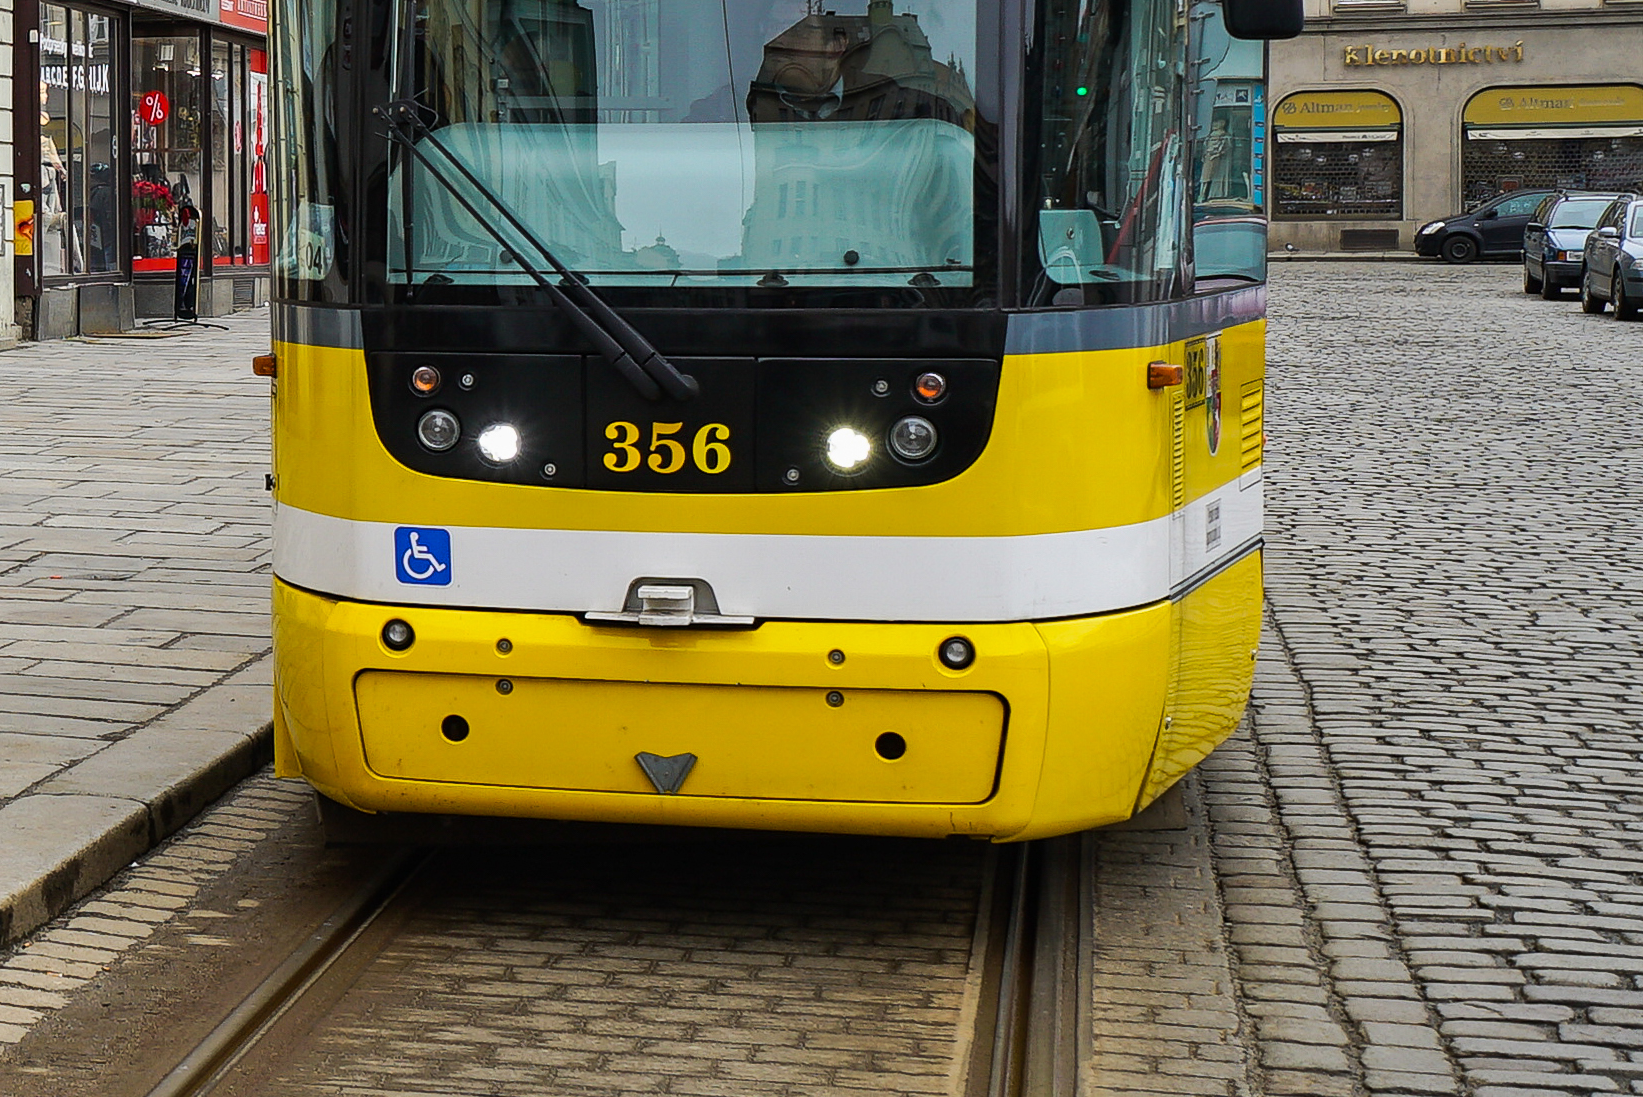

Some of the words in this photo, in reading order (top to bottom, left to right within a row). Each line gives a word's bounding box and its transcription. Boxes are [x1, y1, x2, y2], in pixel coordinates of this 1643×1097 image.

[1343, 40, 1525, 67] Klenotnictví
[1299, 101, 1353, 114] Altman
[1185, 348, 1204, 401] 356
[603, 421, 731, 474] 356
